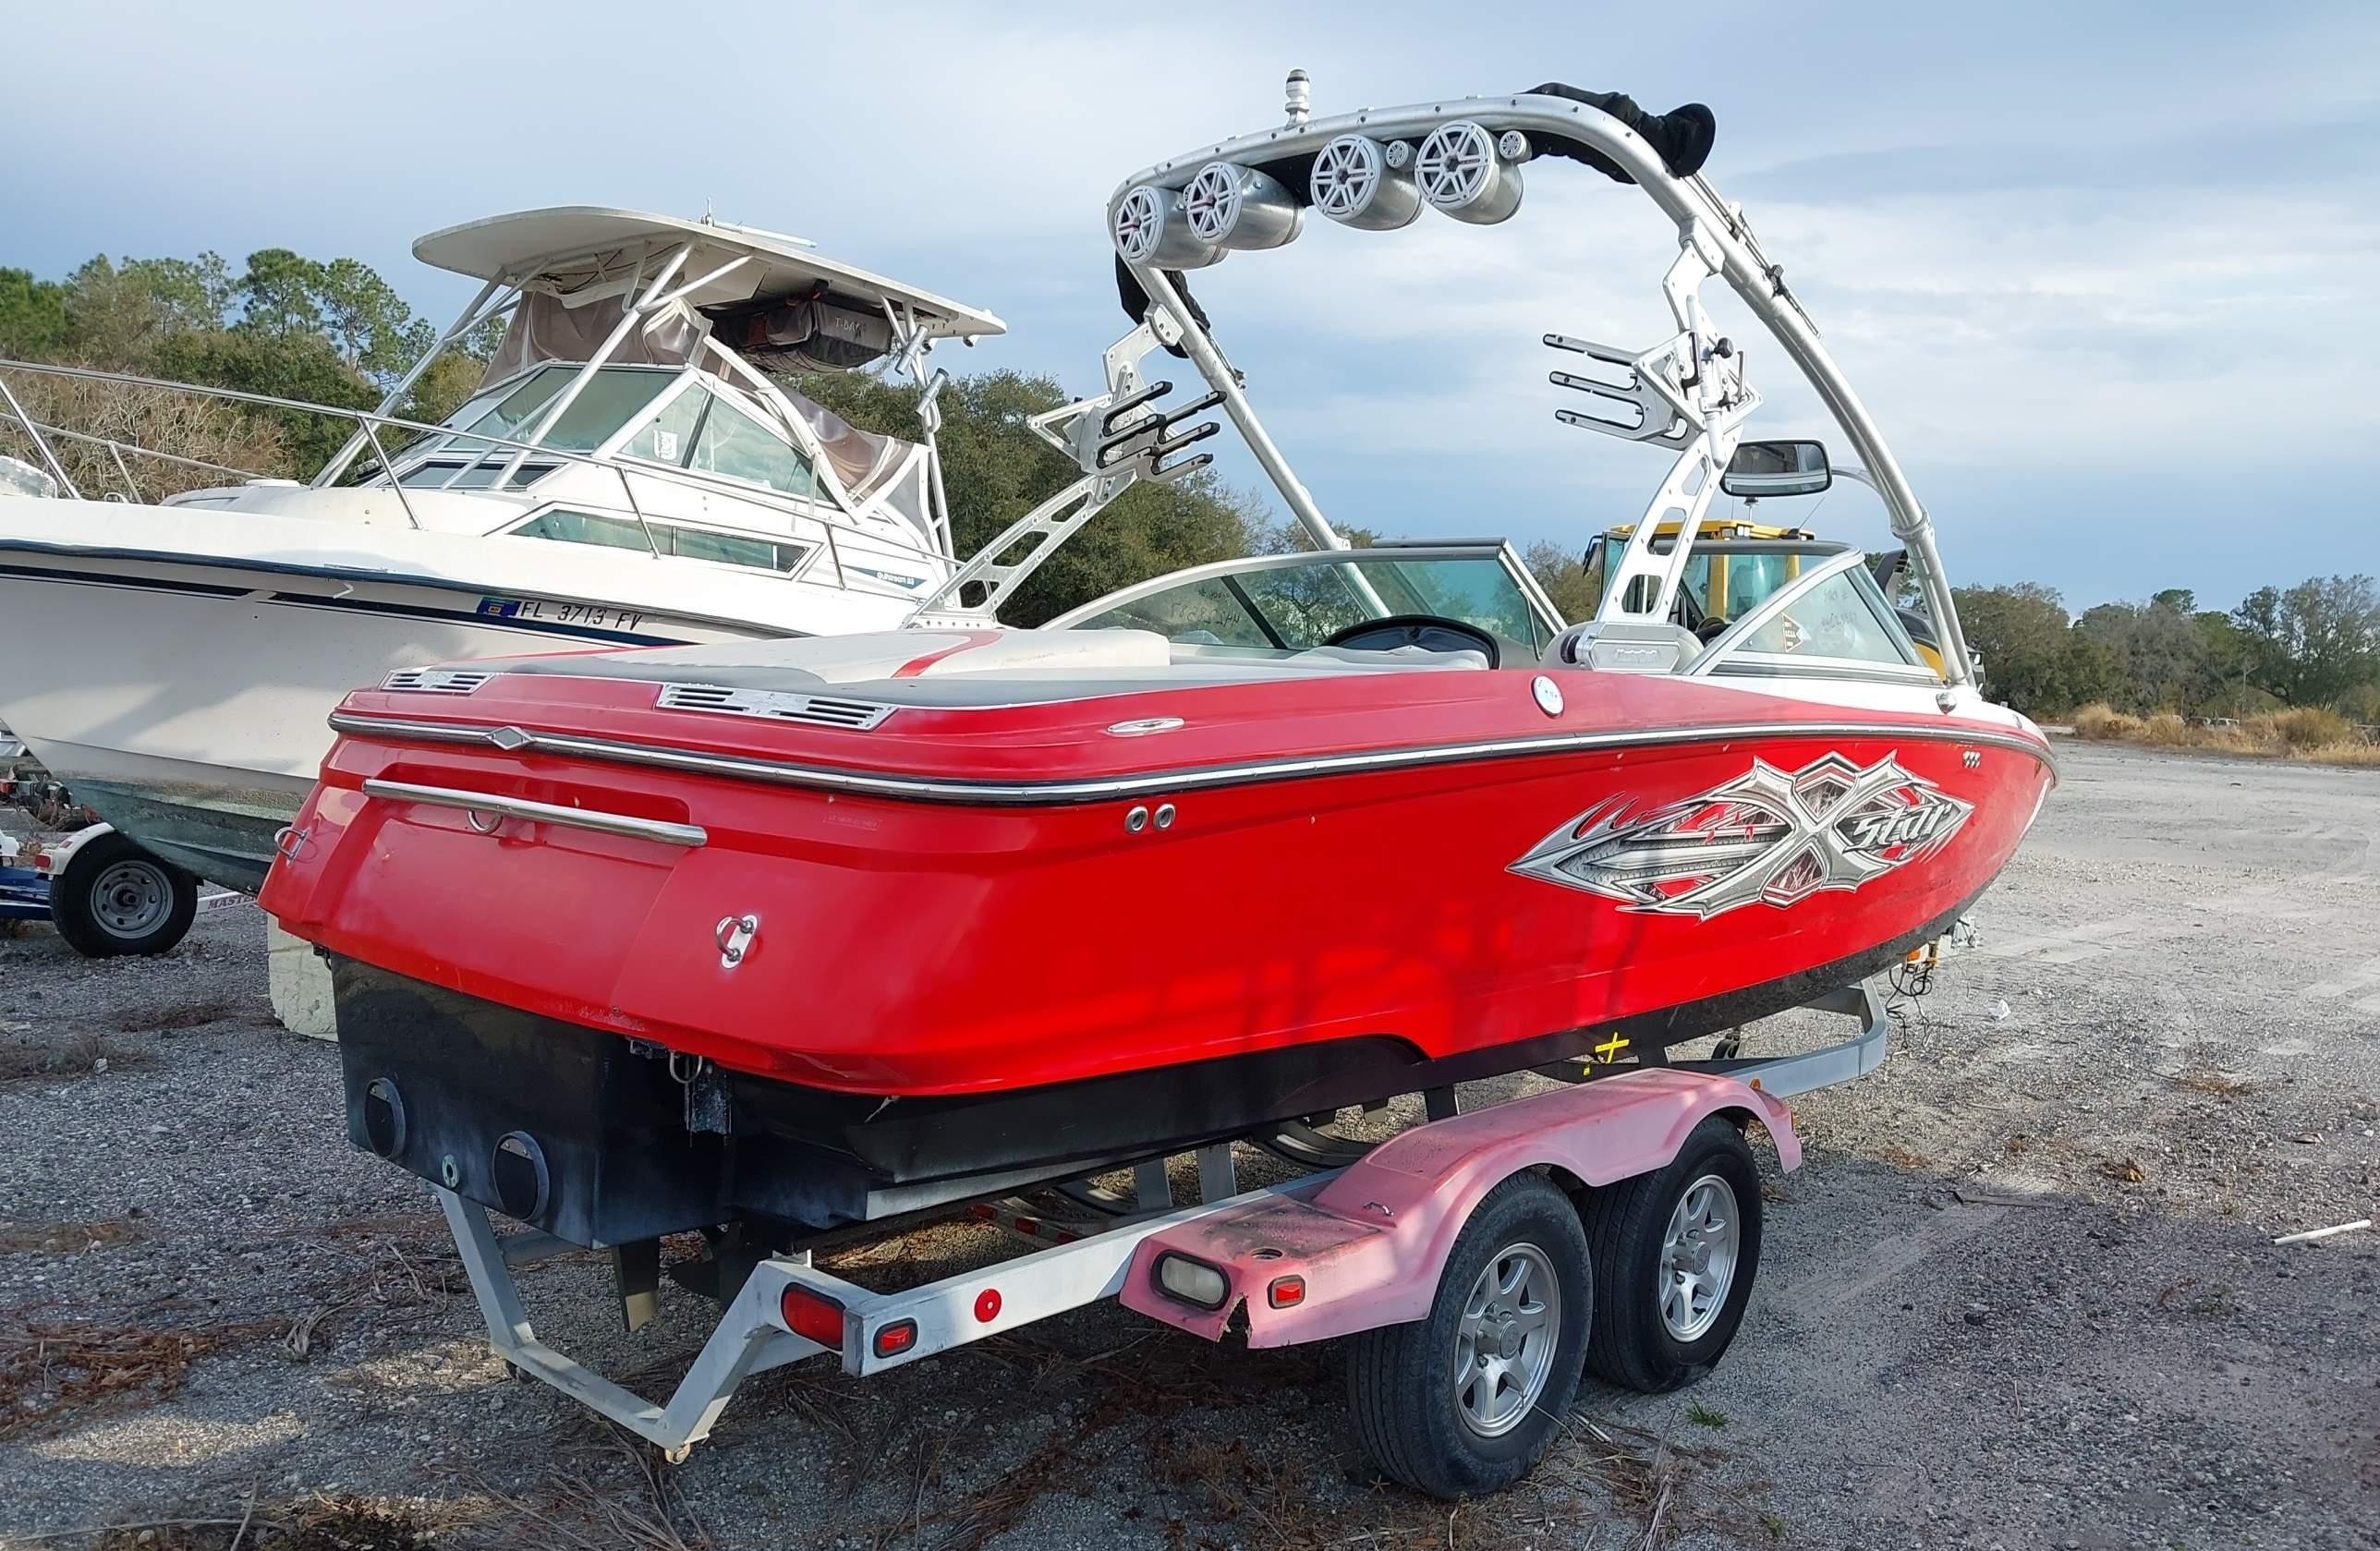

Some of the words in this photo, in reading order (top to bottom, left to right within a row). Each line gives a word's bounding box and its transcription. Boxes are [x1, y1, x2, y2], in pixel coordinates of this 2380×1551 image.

[520, 601, 543, 618] FL
[557, 605, 607, 625] 3713
[614, 612, 643, 631] FV
